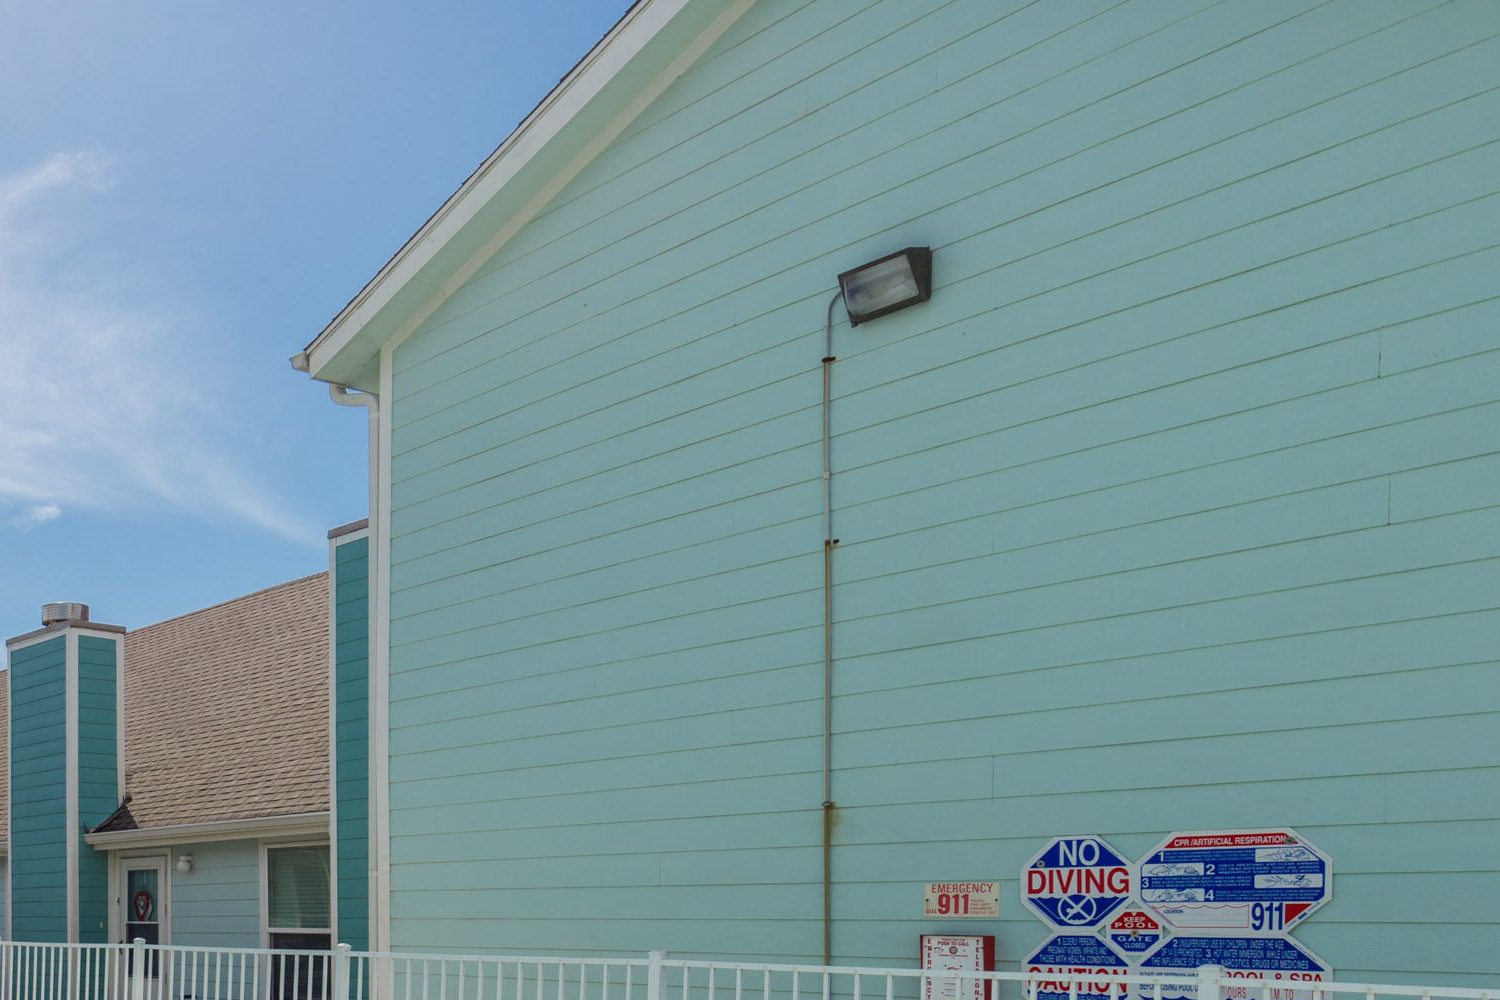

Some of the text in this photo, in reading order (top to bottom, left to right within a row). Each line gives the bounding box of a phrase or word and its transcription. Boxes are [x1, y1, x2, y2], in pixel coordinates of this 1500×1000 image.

[1235, 835, 1287, 845] RESPIRATION
[1059, 839, 1100, 866] NO
[1158, 851, 1165, 862] 1
[1206, 864, 1216, 875] 2
[1027, 867, 1130, 894] DIVING
[1142, 879, 1150, 888] 3
[931, 883, 994, 893] EMERGENCY
[1205, 889, 1215, 900] 4
[938, 893, 969, 914] 911
[1251, 902, 1284, 930] 911
[1173, 940, 1178, 948] 2
[1206, 949, 1211, 957] 3
[1227, 987, 1247, 998] OURS
